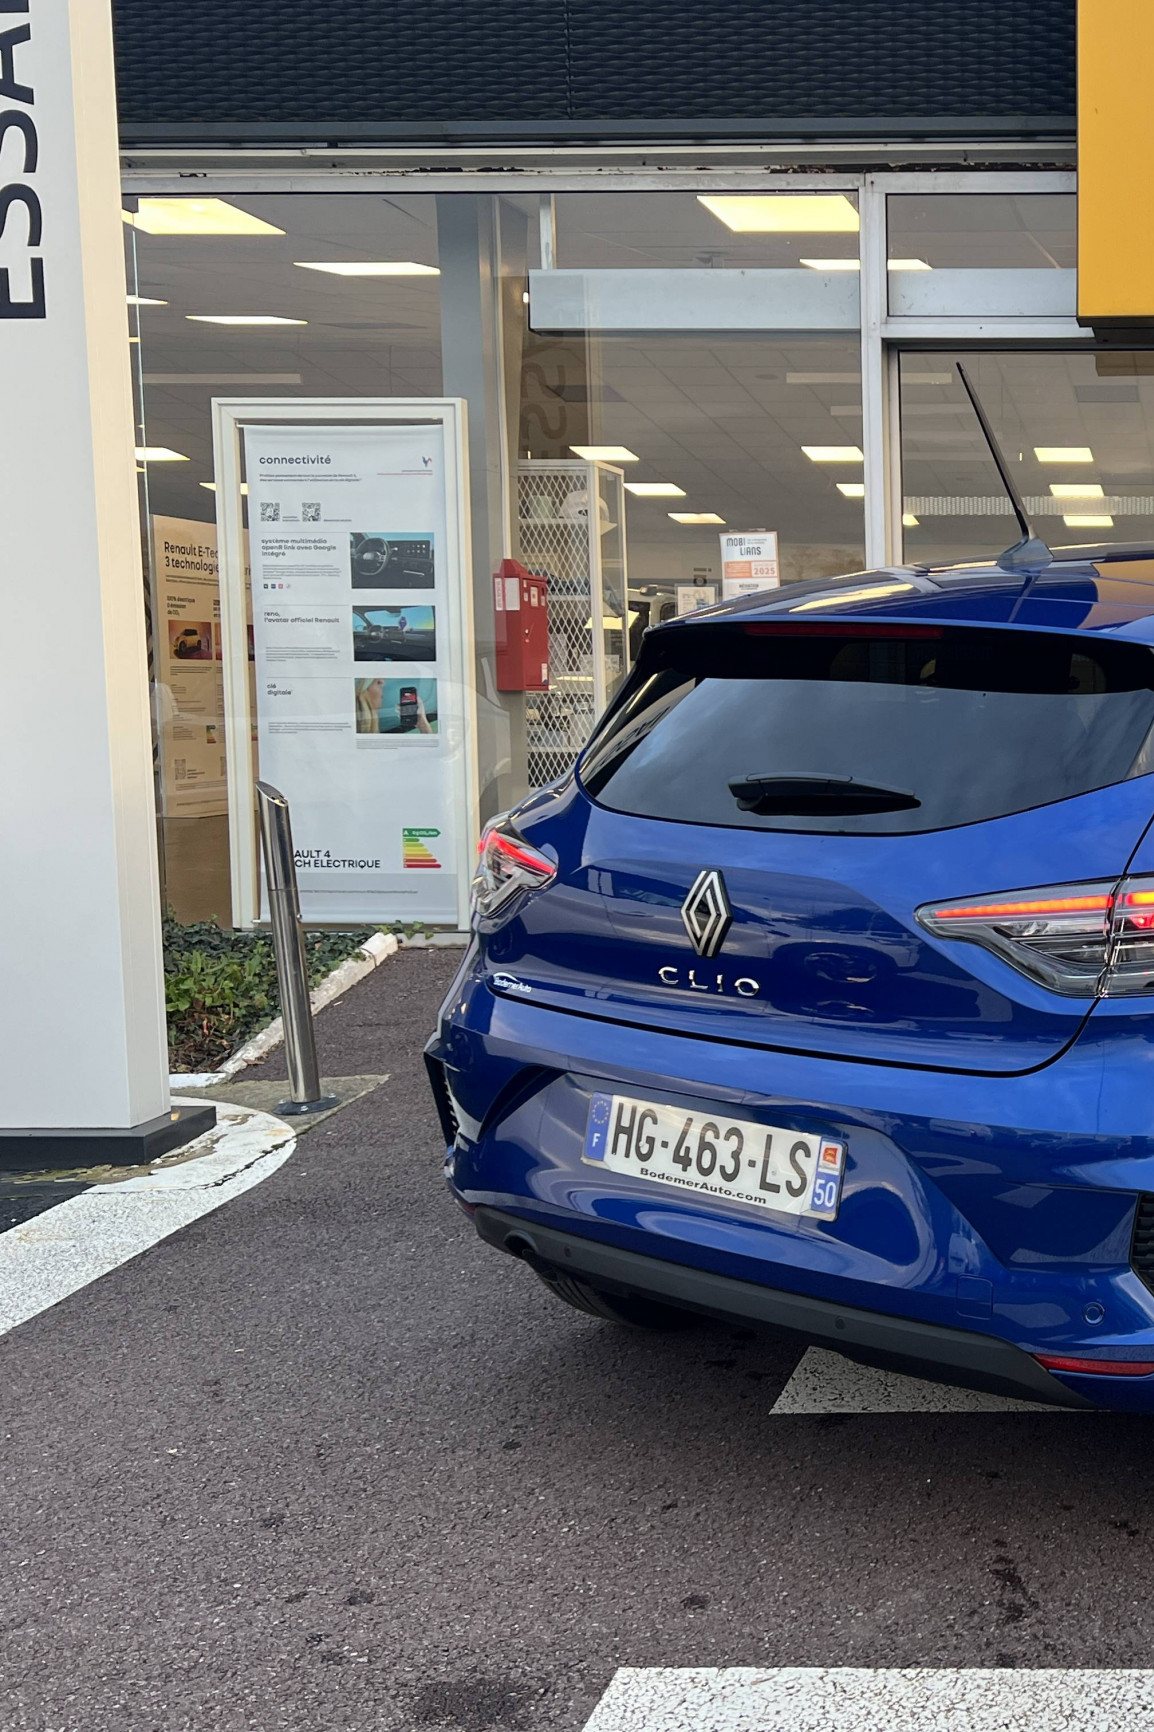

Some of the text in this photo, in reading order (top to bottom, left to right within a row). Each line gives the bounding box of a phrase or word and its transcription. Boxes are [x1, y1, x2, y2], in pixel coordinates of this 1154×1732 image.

[259, 455, 332, 465] connectivité
[726, 537, 746, 547] MOBI
[164, 541, 197, 557] Renault
[739, 546, 762, 556] LIANS
[165, 556, 171, 568] 3
[753, 567, 776, 575] 2025
[324, 850, 331, 859] 4
[314, 859, 381, 869] ELECTRIQUE
[658, 966, 760, 996] CLIO
[591, 1102, 838, 1208] F HG-463-LS 50
[640, 1166, 767, 1205] BodemerAuto.com
